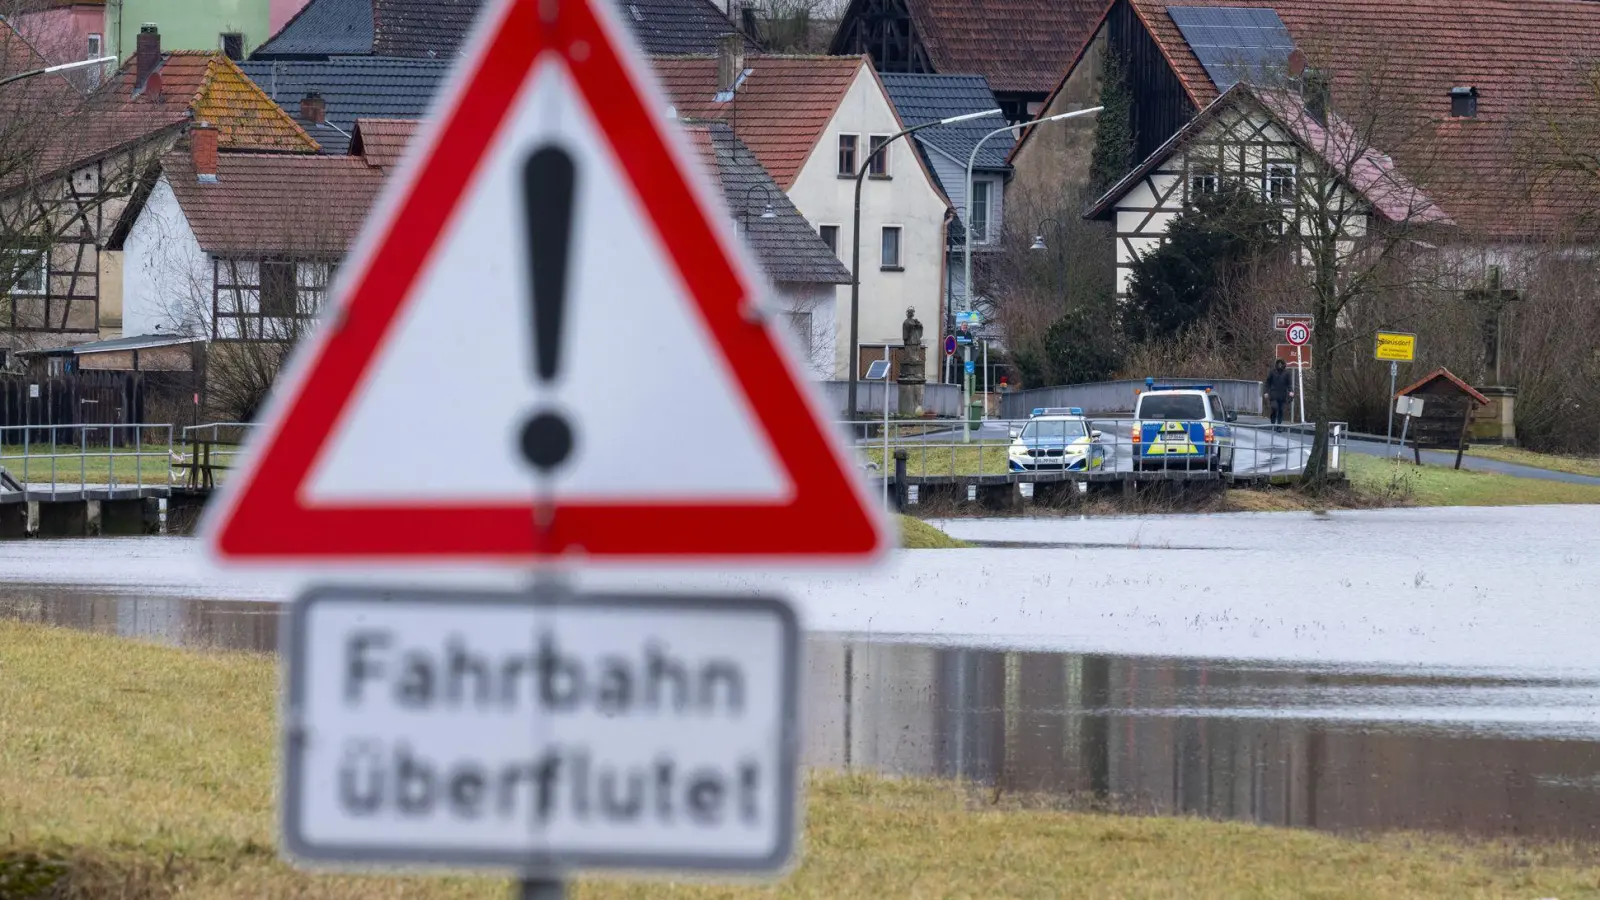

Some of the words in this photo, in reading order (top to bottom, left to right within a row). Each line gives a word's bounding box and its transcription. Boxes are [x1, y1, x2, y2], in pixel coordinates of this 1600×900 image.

[1291, 329, 1305, 340] 30
[344, 630, 746, 714] Fahrbahn
[339, 740, 760, 823] überflutet
